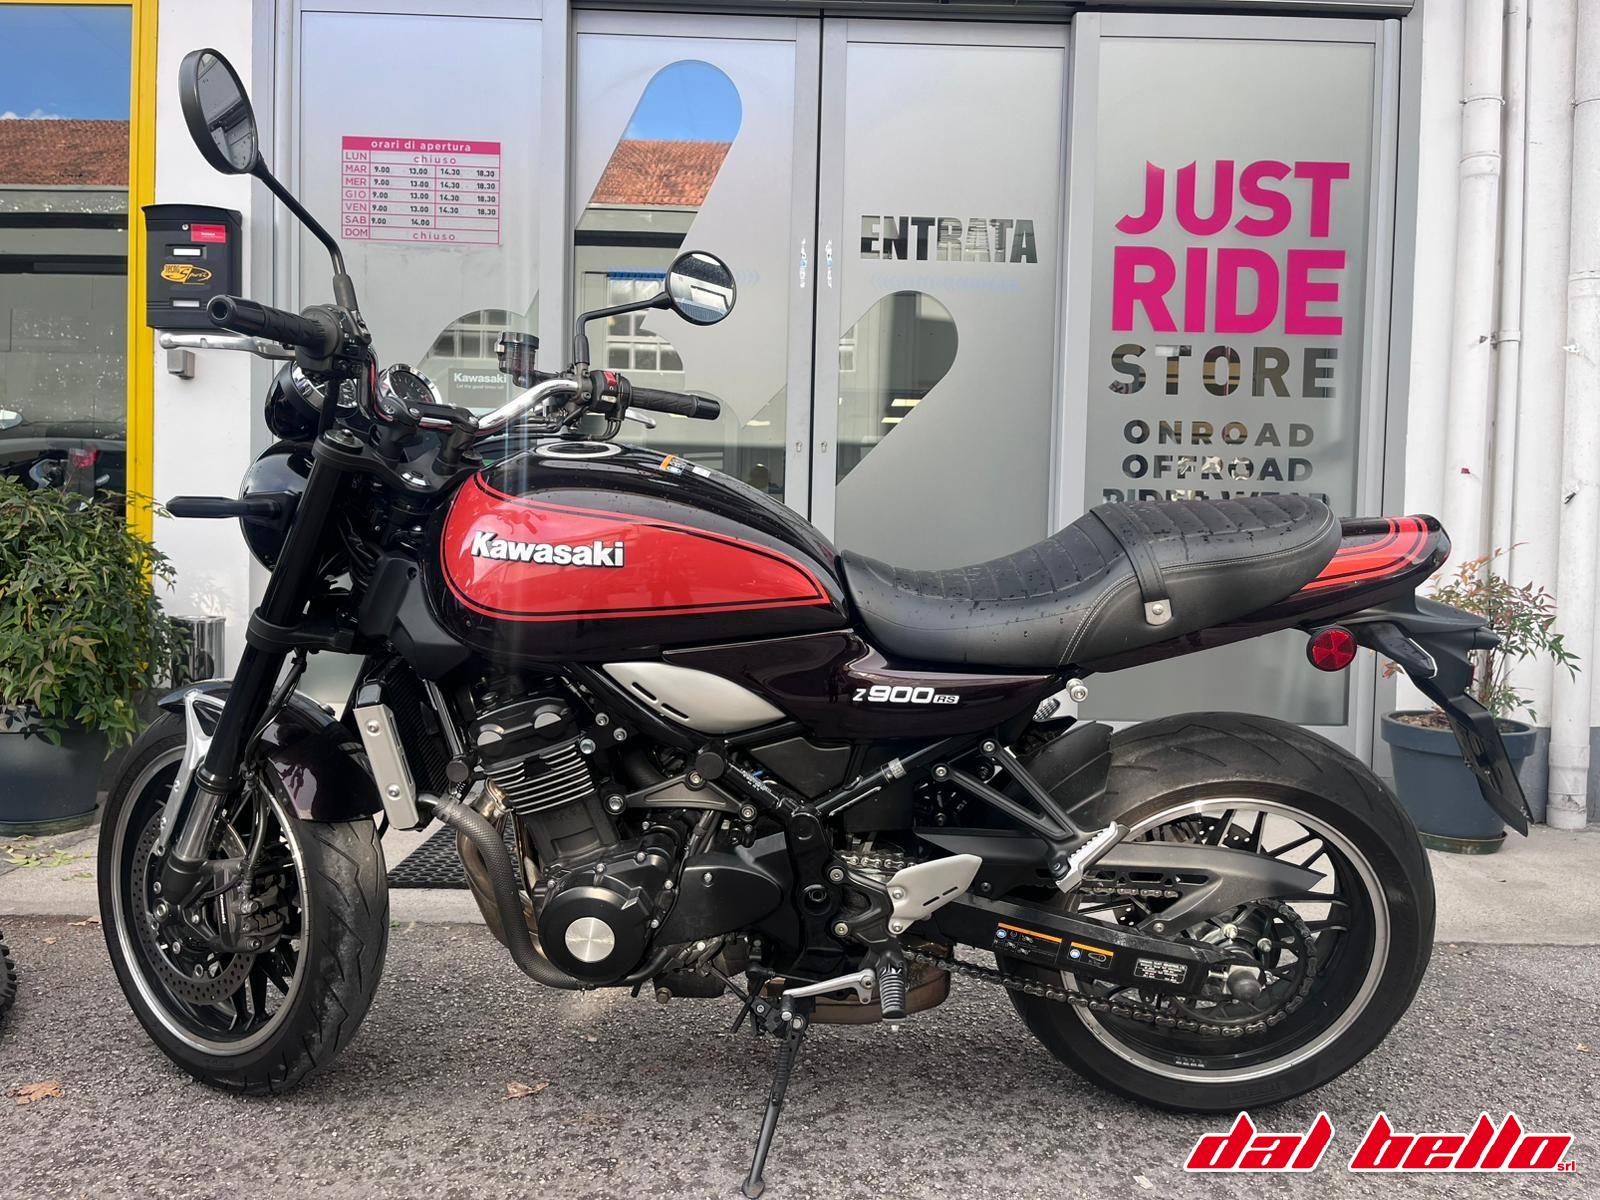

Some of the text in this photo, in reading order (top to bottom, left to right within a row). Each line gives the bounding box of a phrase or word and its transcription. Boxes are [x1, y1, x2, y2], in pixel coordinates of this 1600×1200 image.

[371, 140, 471, 152] orari di apertura
[345, 152, 457, 164] LUN chiuso
[345, 164, 367, 174] MAR
[374, 166, 390, 174] 9.00
[440, 168, 460, 176] 14.30
[476, 170, 495, 178] 18.30
[345, 178, 367, 186] MER
[410, 180, 430, 188] 13.00
[440, 181, 460, 189] 14.30
[345, 190, 367, 198] GIO
[1114, 160, 1350, 238] JUST
[345, 202, 367, 212] VEN
[345, 215, 367, 224] SAB
[345, 228, 456, 240] DOM chiuso
[861, 215, 1038, 264] ENTRATA
[1112, 246, 1346, 336] RIDE
[1108, 343, 1338, 398] STORE
[454, 372, 507, 384] Kawasaki
[1123, 419, 1314, 448] ONROAD
[1122, 453, 1313, 482] OFFROAD
[471, 530, 625, 568] Kawasaki
